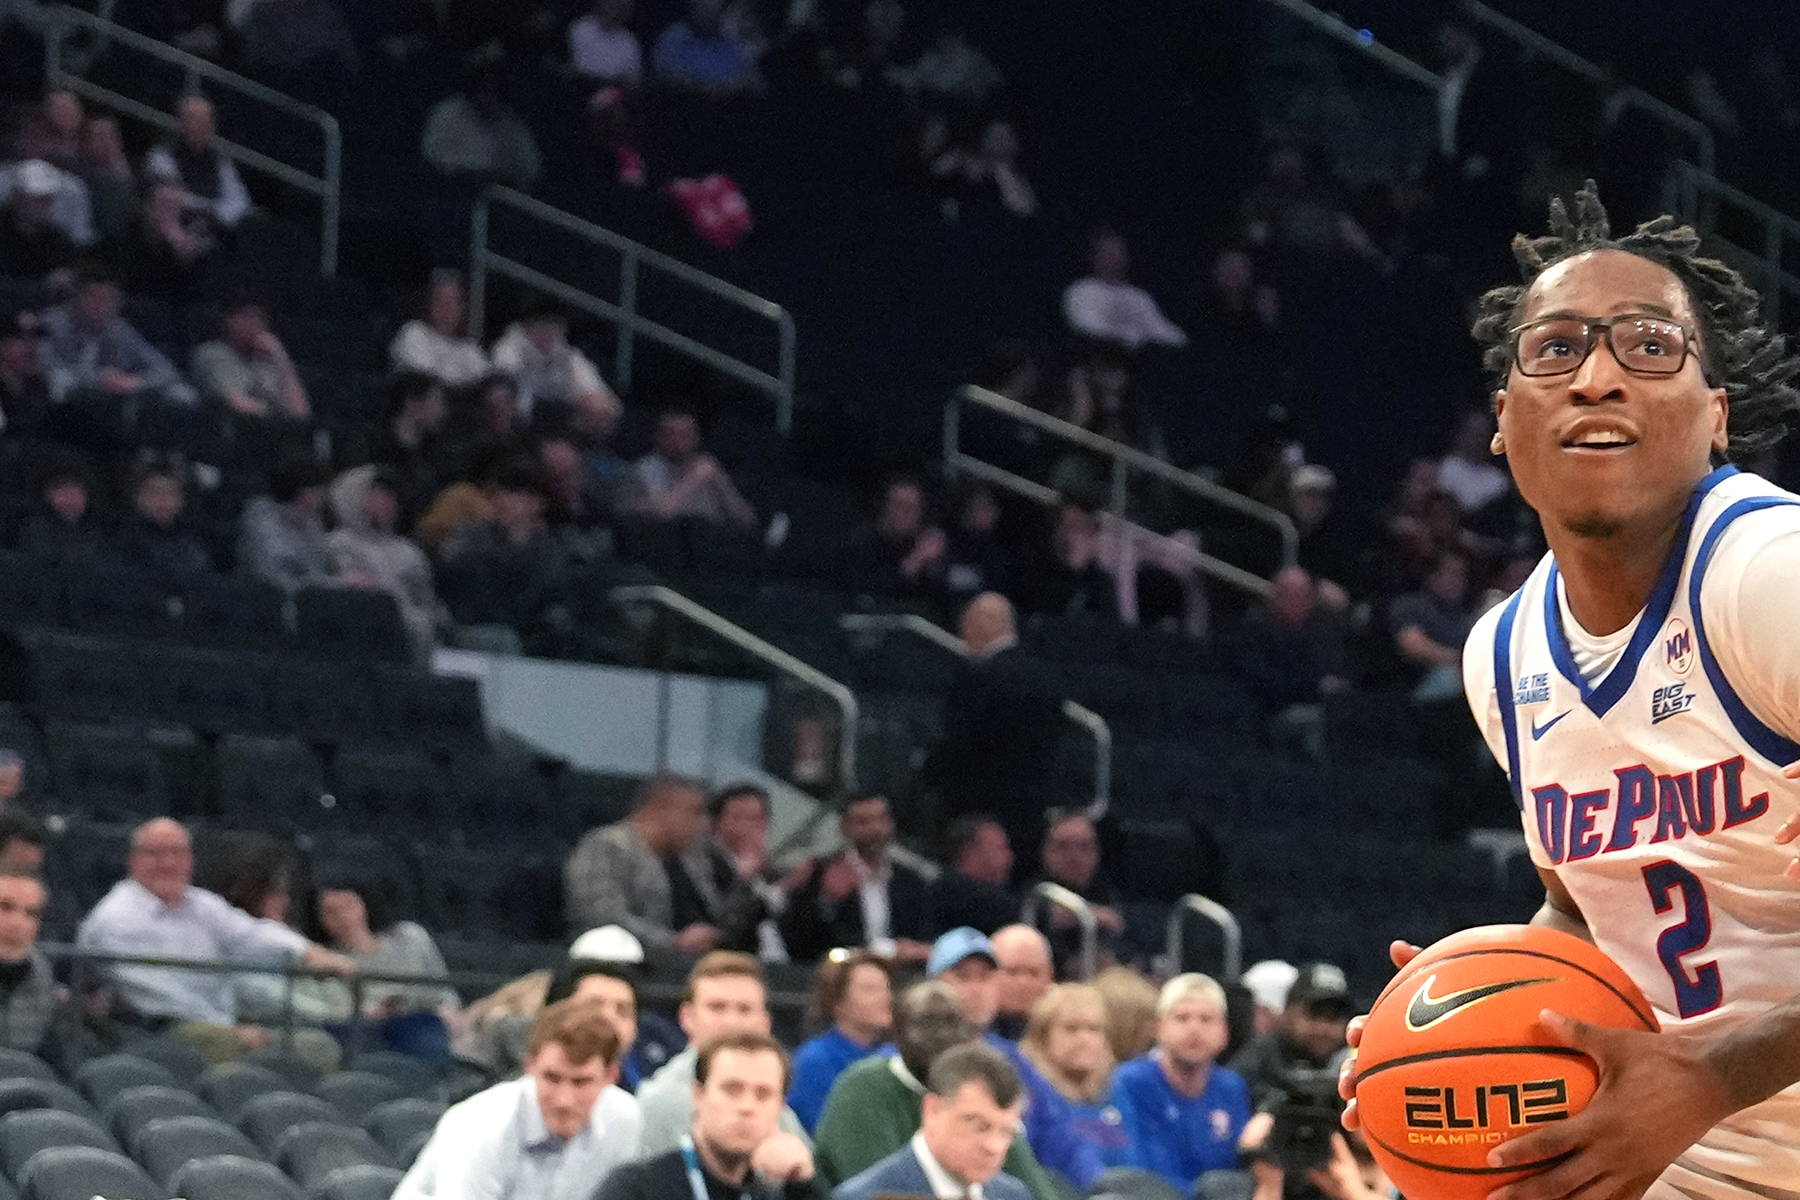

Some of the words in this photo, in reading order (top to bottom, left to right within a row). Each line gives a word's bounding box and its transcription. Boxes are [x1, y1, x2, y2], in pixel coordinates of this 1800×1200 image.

[1531, 672, 1550, 689] THE
[1652, 682, 1686, 704] BIG
[1652, 694, 1697, 718] EAST
[1641, 859, 1723, 1020] 2
[1404, 1078, 1569, 1130] ELITE
[1407, 1131, 1508, 1146] CHAMPIO
